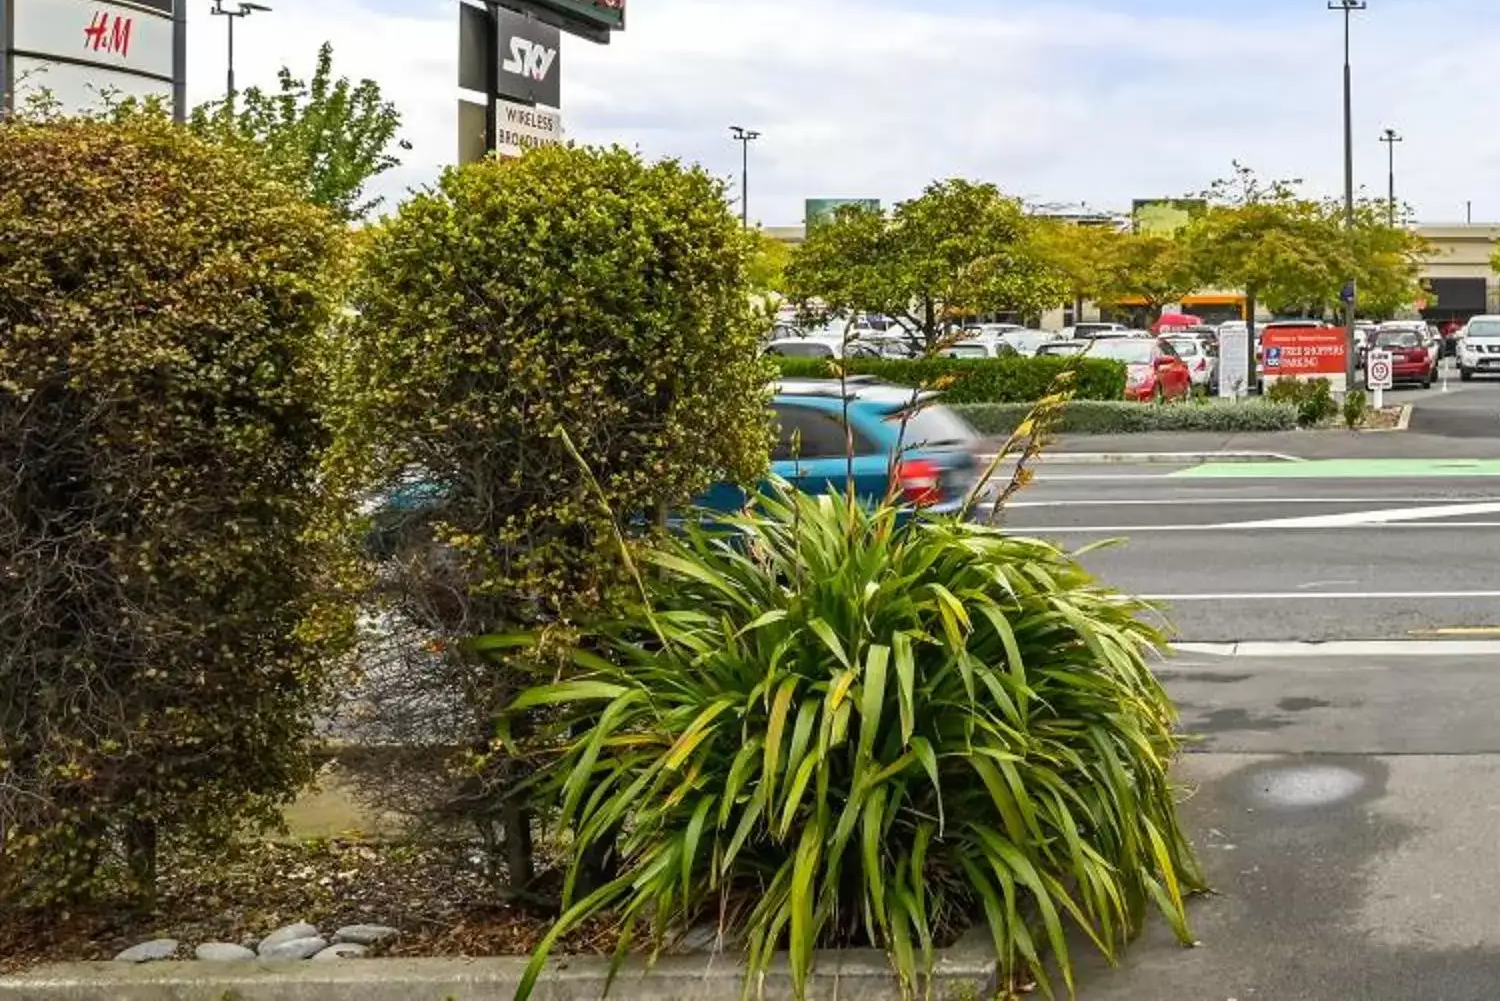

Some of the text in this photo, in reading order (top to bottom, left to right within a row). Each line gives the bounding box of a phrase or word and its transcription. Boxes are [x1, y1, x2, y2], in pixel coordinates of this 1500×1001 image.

[84, 10, 133, 58] H&M
[503, 36, 556, 82] SKY
[505, 106, 553, 132] WIRELESS
